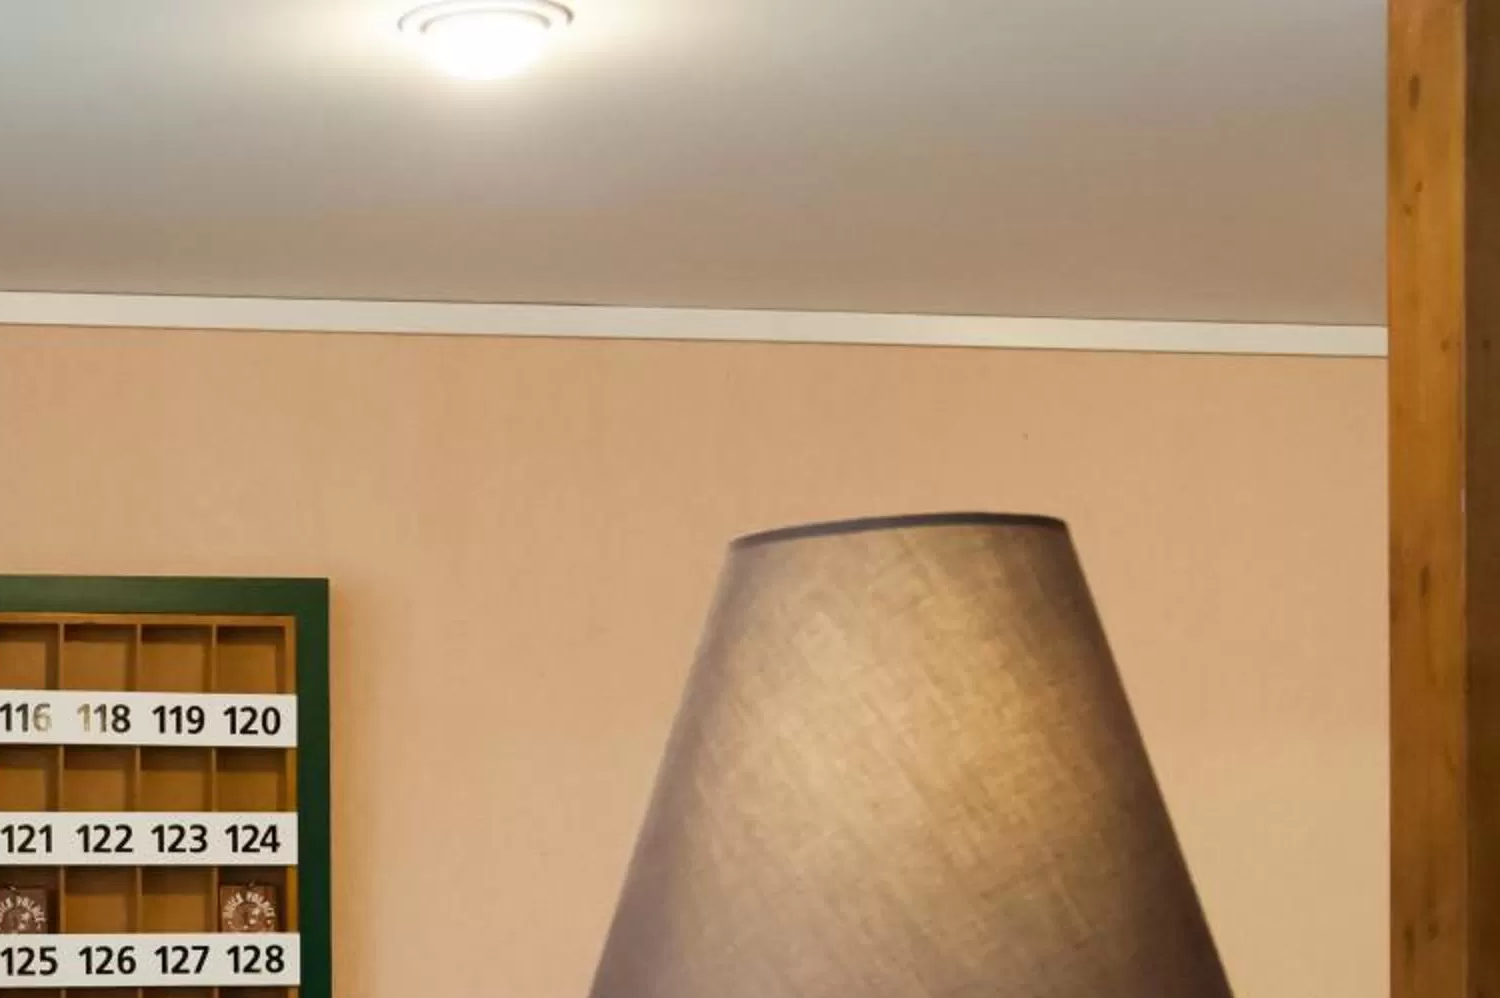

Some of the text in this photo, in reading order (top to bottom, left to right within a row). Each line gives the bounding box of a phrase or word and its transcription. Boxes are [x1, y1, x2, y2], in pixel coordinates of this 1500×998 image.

[77, 704, 131, 734] 118
[152, 705, 205, 734] 119
[223, 706, 281, 736] 120
[0, 824, 281, 854] 121 122 123 124
[0, 944, 285, 976] 125 126 127 128
